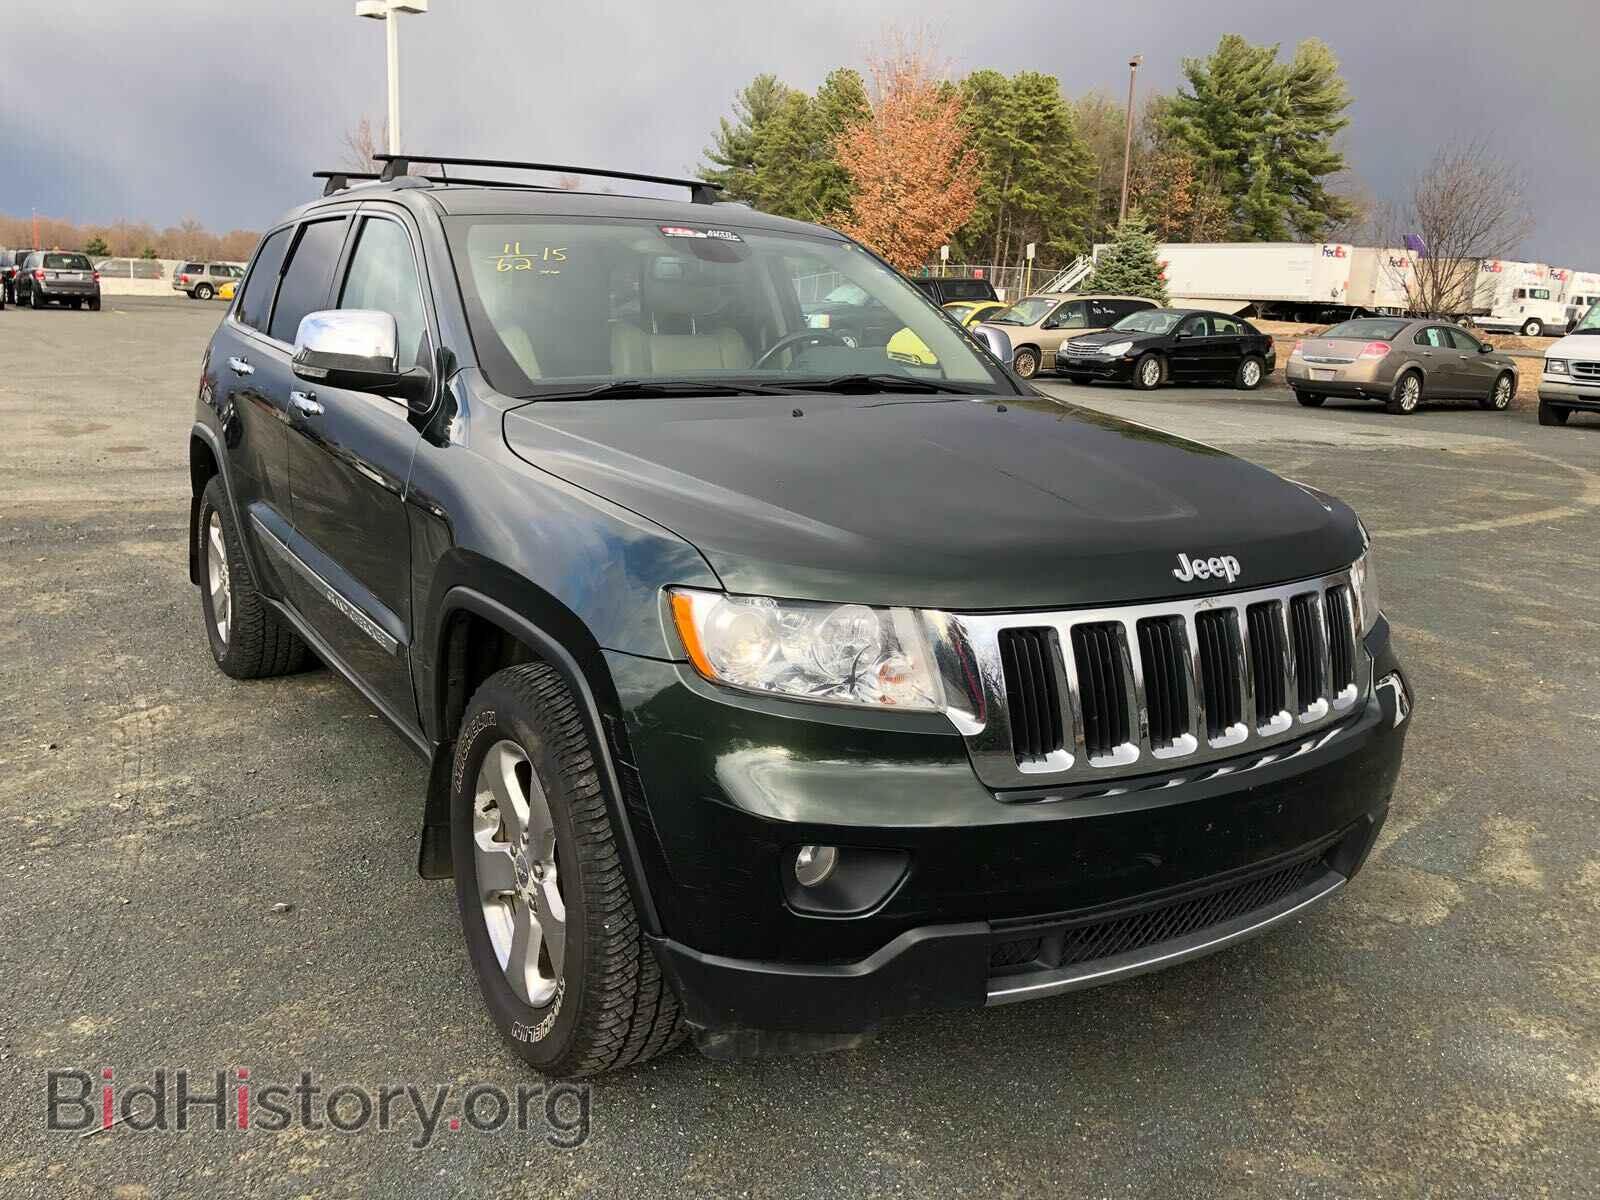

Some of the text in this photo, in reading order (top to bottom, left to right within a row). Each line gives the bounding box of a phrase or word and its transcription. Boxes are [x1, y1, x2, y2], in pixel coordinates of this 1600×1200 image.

[543, 247, 569, 260] 15
[1321, 245, 1346, 258] FedEx
[497, 257, 532, 272] 62
[1388, 256, 1409, 268] FedEx
[1481, 260, 1502, 272] FedEx
[1172, 552, 1241, 583] Jeep
